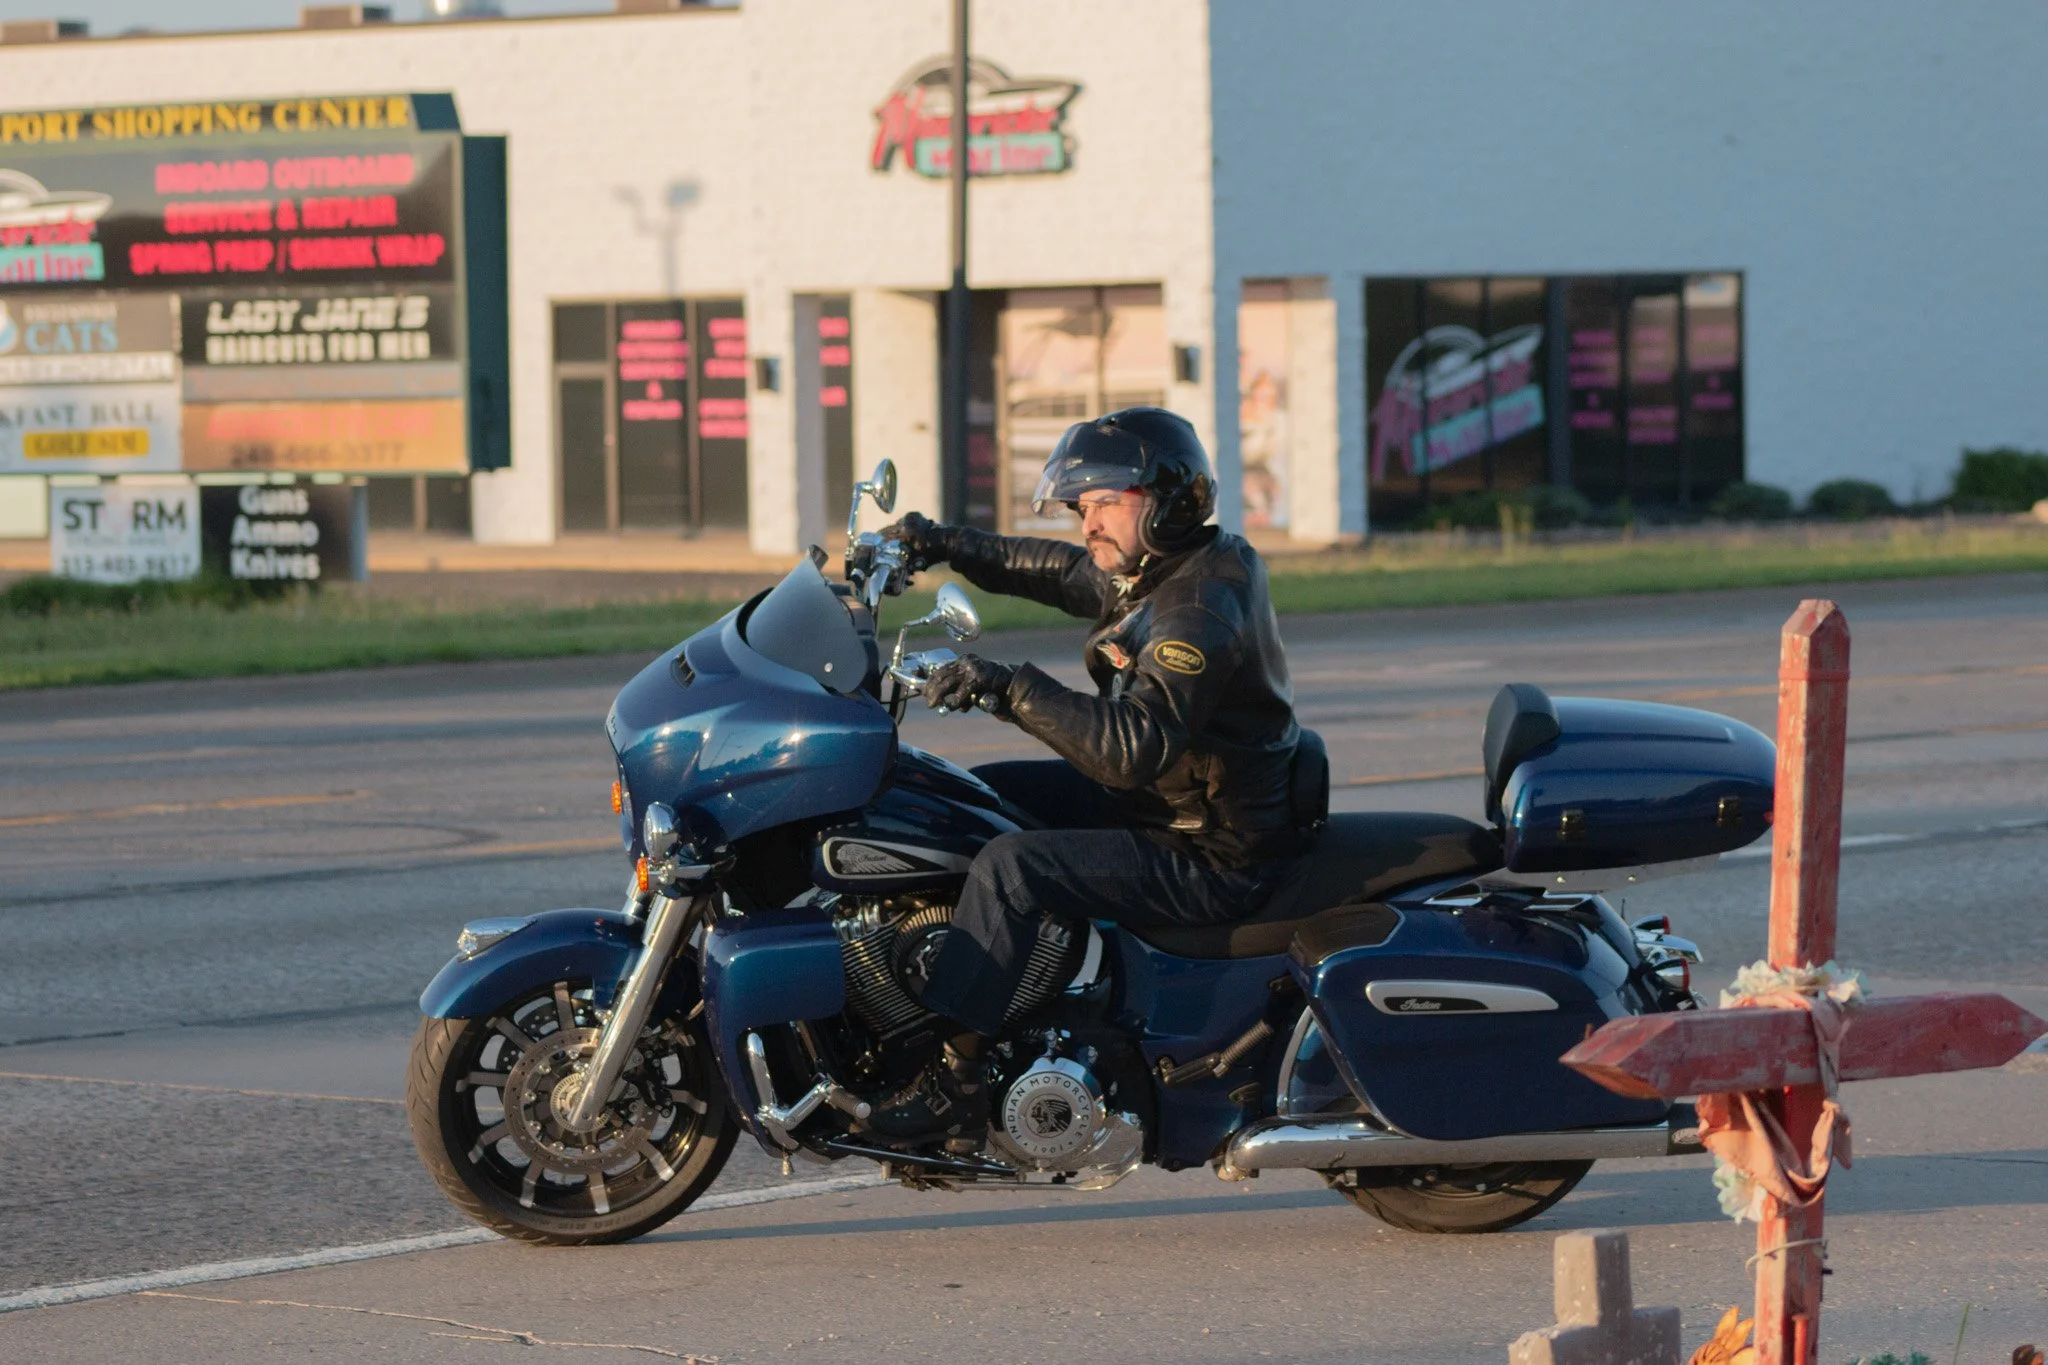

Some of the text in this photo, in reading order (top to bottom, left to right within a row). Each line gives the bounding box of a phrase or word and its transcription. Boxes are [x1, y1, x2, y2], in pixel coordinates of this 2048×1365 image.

[92, 103, 261, 140] SHOPPING
[273, 96, 408, 133] CENTER
[207, 299, 302, 334] LADY
[24, 319, 119, 354] CATS
[327, 332, 375, 363] FOR
[238, 485, 310, 516] Guns
[230, 514, 320, 548] Ammo
[230, 548, 321, 580] Knives
[1400, 998, 1441, 1011] Indian
[1007, 1075, 1091, 1140] INDIAN MOTORCYCLE
[1033, 1144, 1064, 1154] 1901
